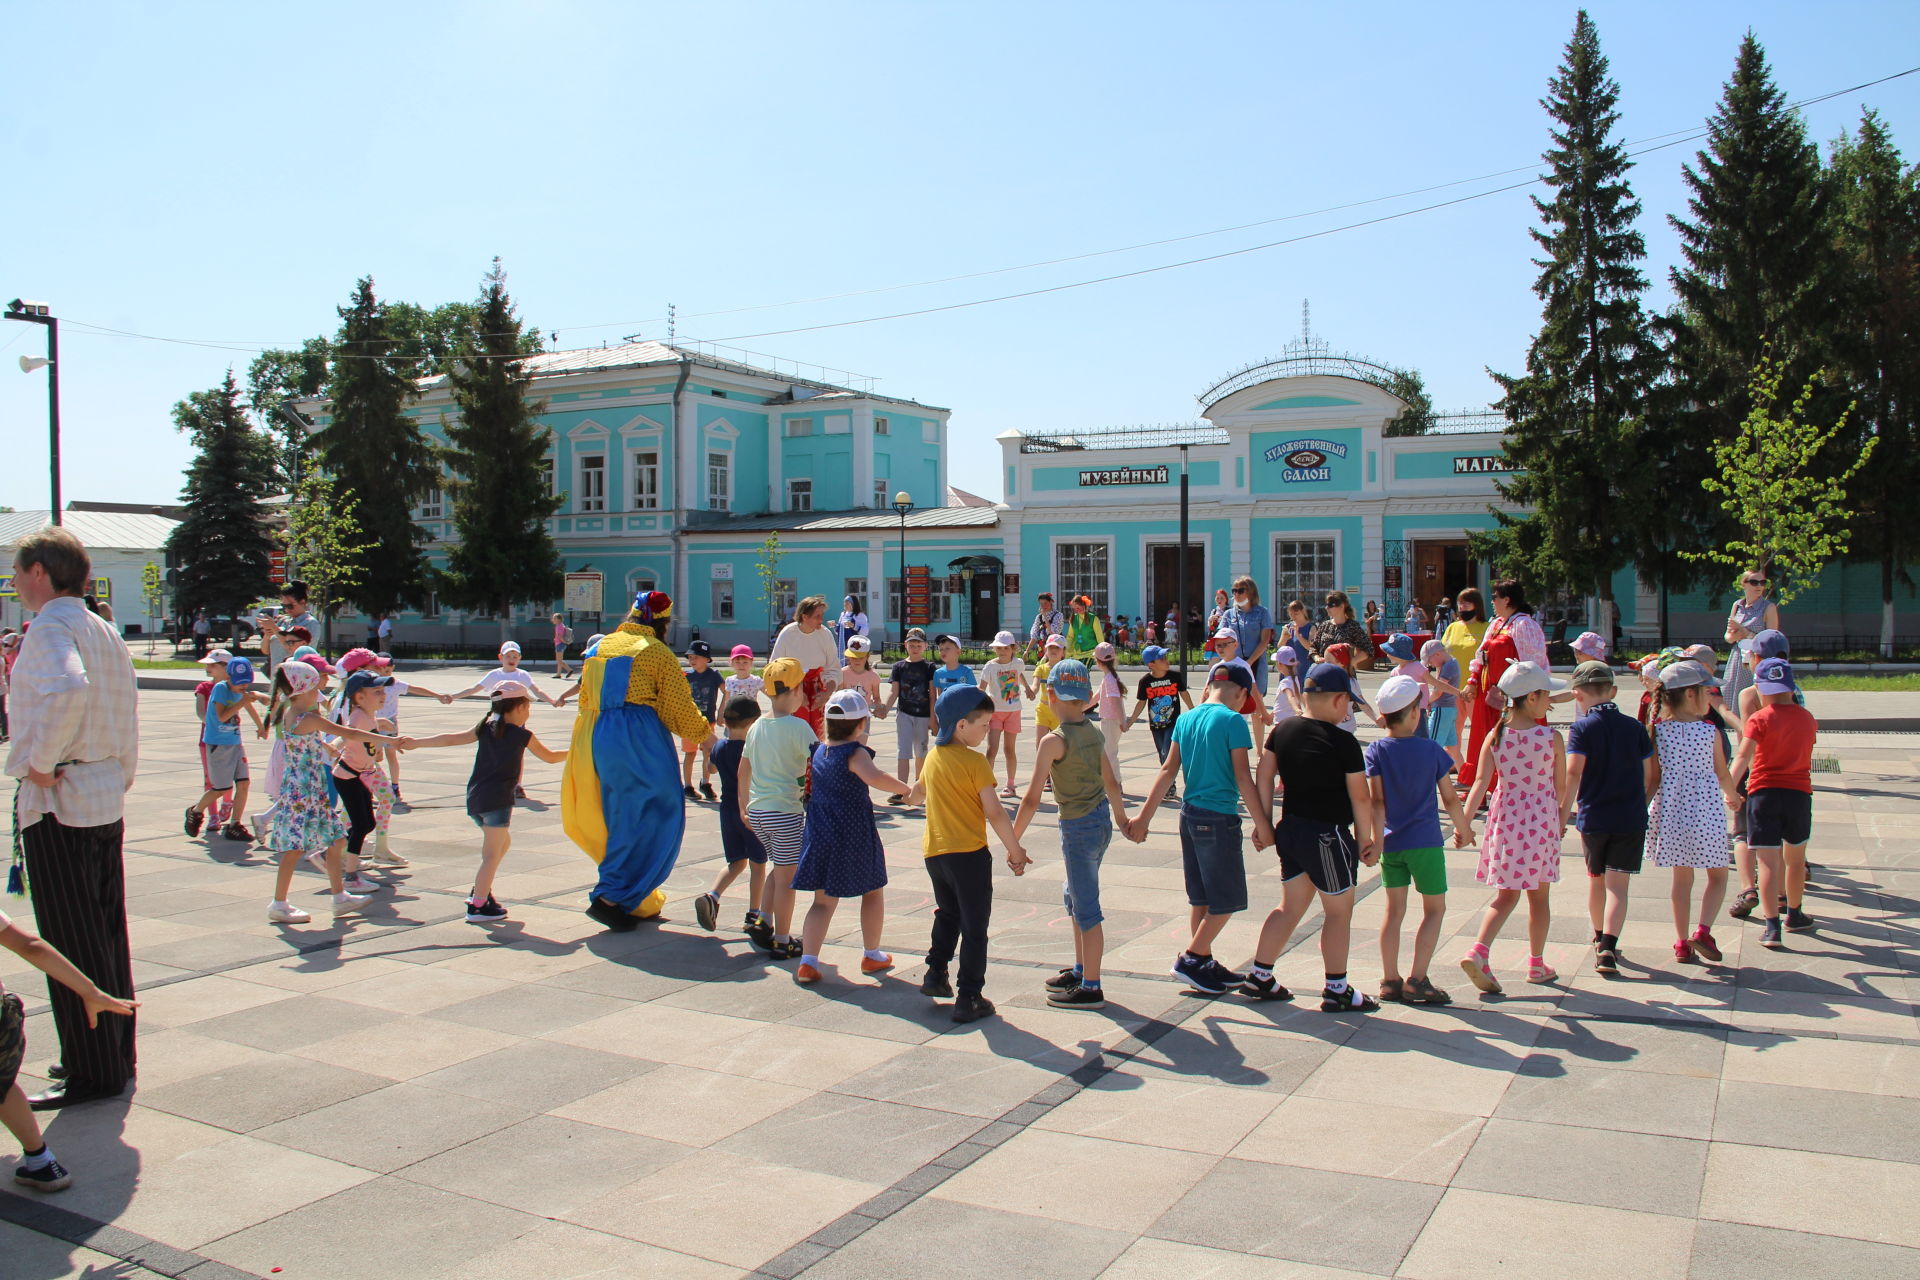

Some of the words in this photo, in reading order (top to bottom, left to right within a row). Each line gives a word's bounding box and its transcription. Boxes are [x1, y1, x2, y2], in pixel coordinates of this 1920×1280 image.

[1265, 439, 1347, 461] ХУДОЖЕСТВЕННЫЙ
[1455, 457, 1528, 472] МАГА
[1080, 466, 1168, 485] МУЗЕЙНЫЙ
[1283, 468, 1329, 481] САЛОН
[1146, 683, 1178, 699] STARS
[1255, 970, 1271, 978] FILA
